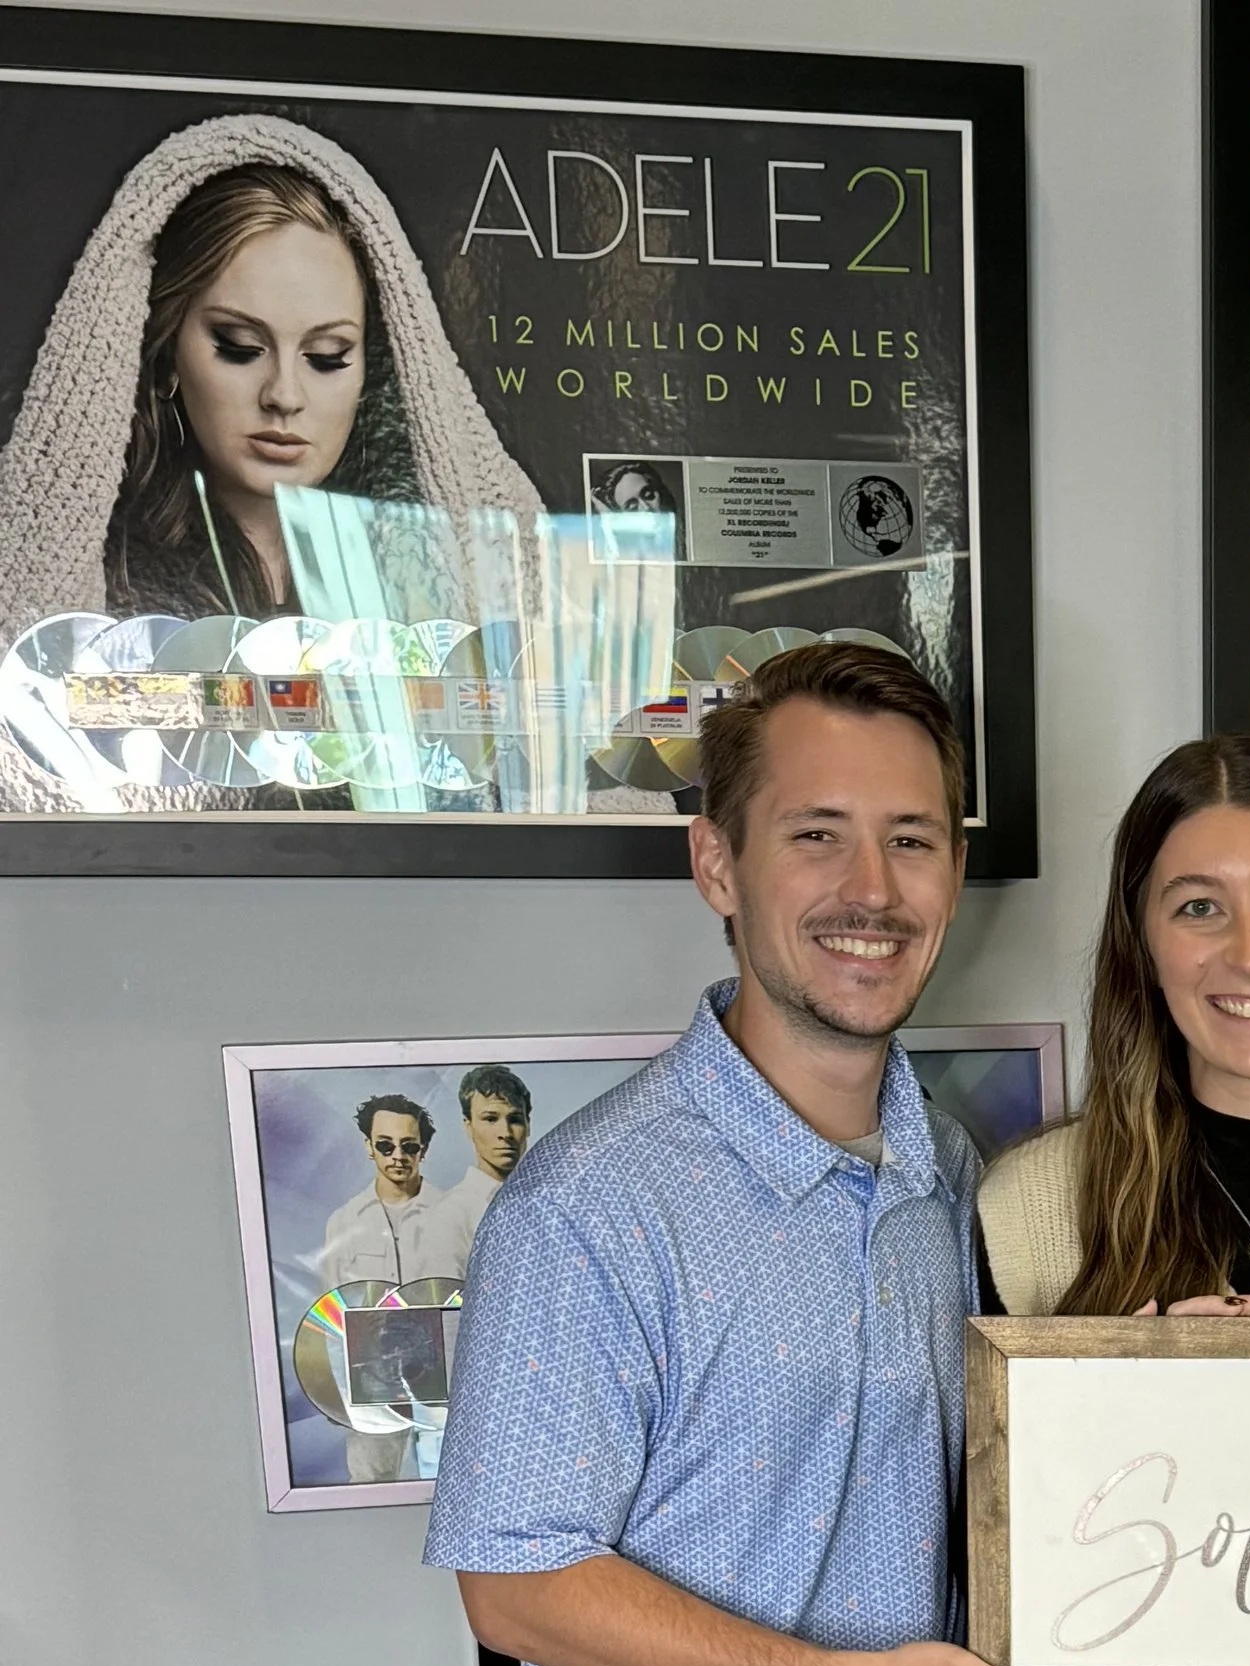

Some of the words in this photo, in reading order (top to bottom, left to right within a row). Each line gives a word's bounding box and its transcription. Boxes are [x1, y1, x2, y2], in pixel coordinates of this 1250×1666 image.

[460, 146, 831, 271] ADELE
[846, 166, 931, 274] 21
[487, 315, 535, 346] 12
[565, 318, 760, 353] MILLION
[789, 326, 920, 360] SALES
[496, 365, 918, 410] WORLDWIDE
